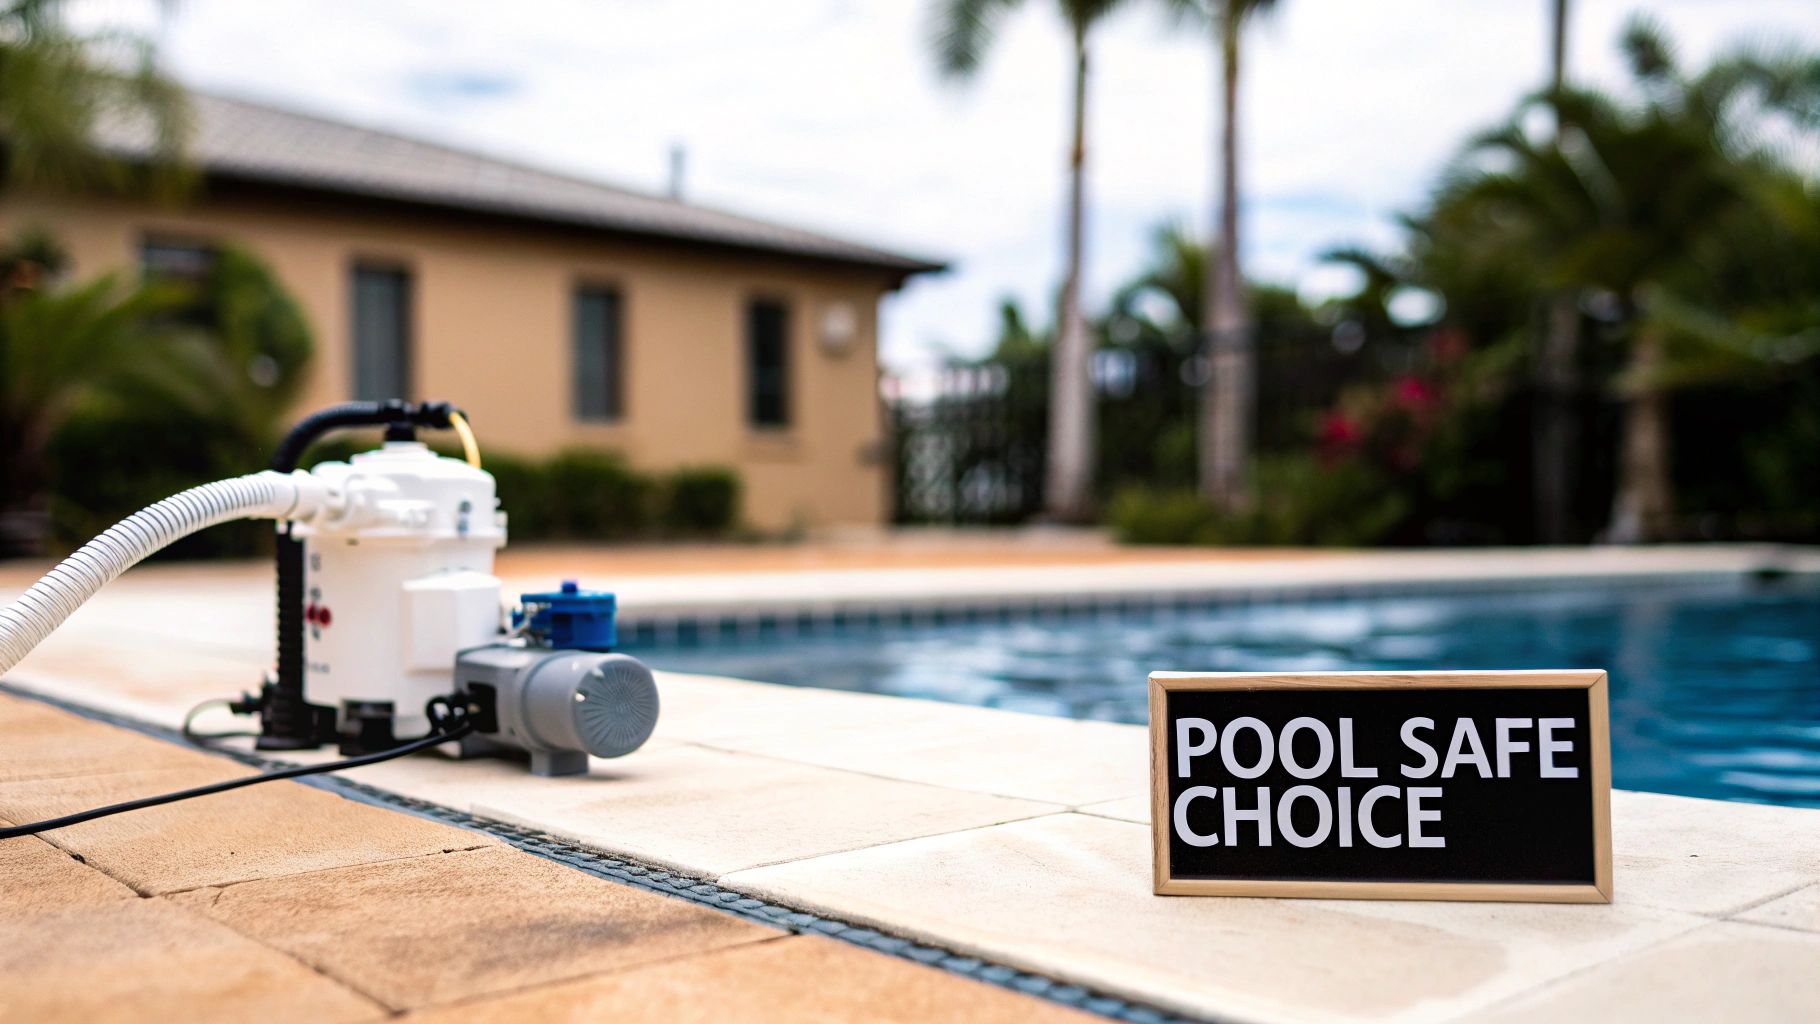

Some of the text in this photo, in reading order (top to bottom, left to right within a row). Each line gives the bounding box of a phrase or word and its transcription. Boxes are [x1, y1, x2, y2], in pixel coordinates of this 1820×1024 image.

[1176, 716, 1579, 780] POOL SAFE
[1173, 784, 1446, 849] CHOICE
